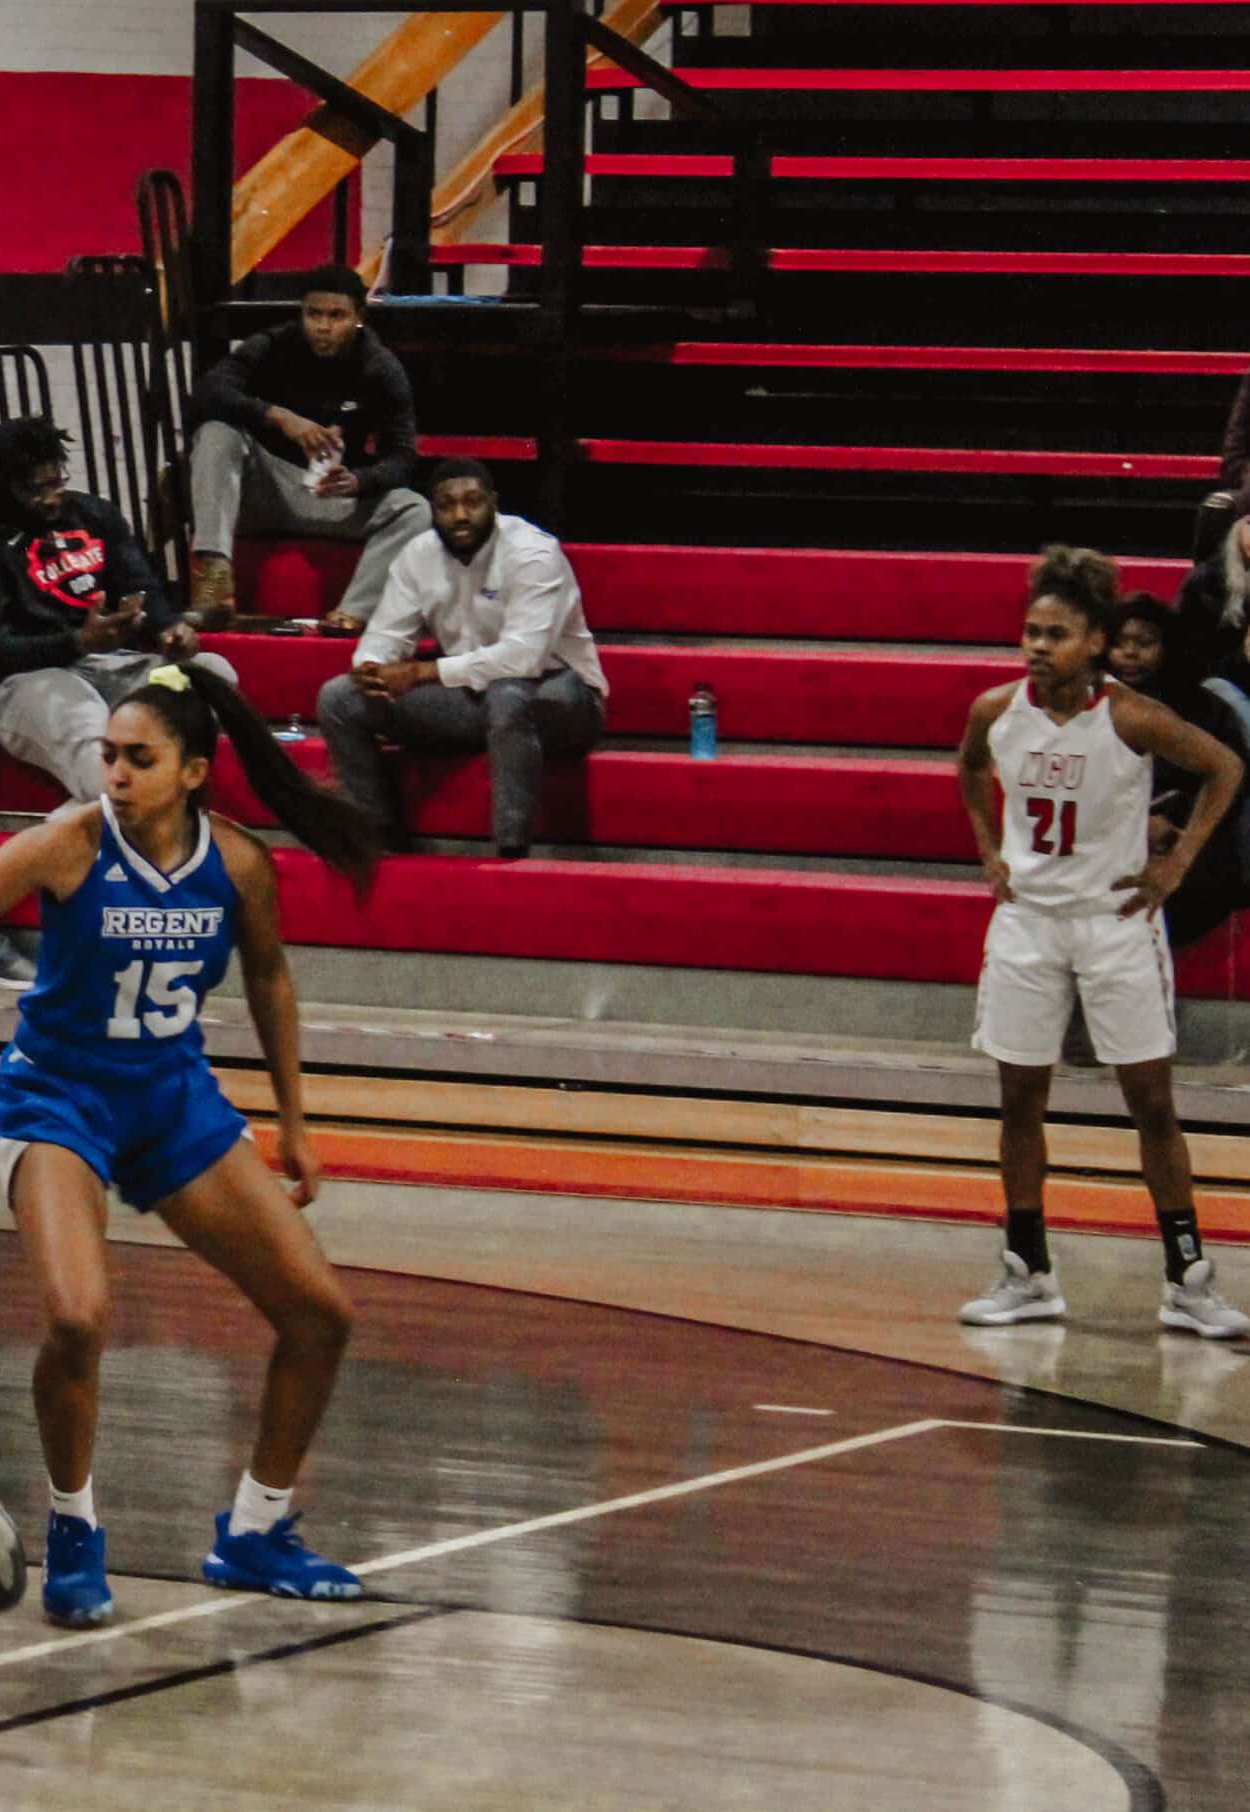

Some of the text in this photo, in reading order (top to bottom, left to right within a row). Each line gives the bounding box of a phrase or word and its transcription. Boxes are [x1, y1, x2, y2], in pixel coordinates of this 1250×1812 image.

[1027, 797, 1077, 856] 21
[103, 908, 223, 937] REGENT
[132, 939, 195, 950] ROYALS
[107, 960, 204, 1039] 15
